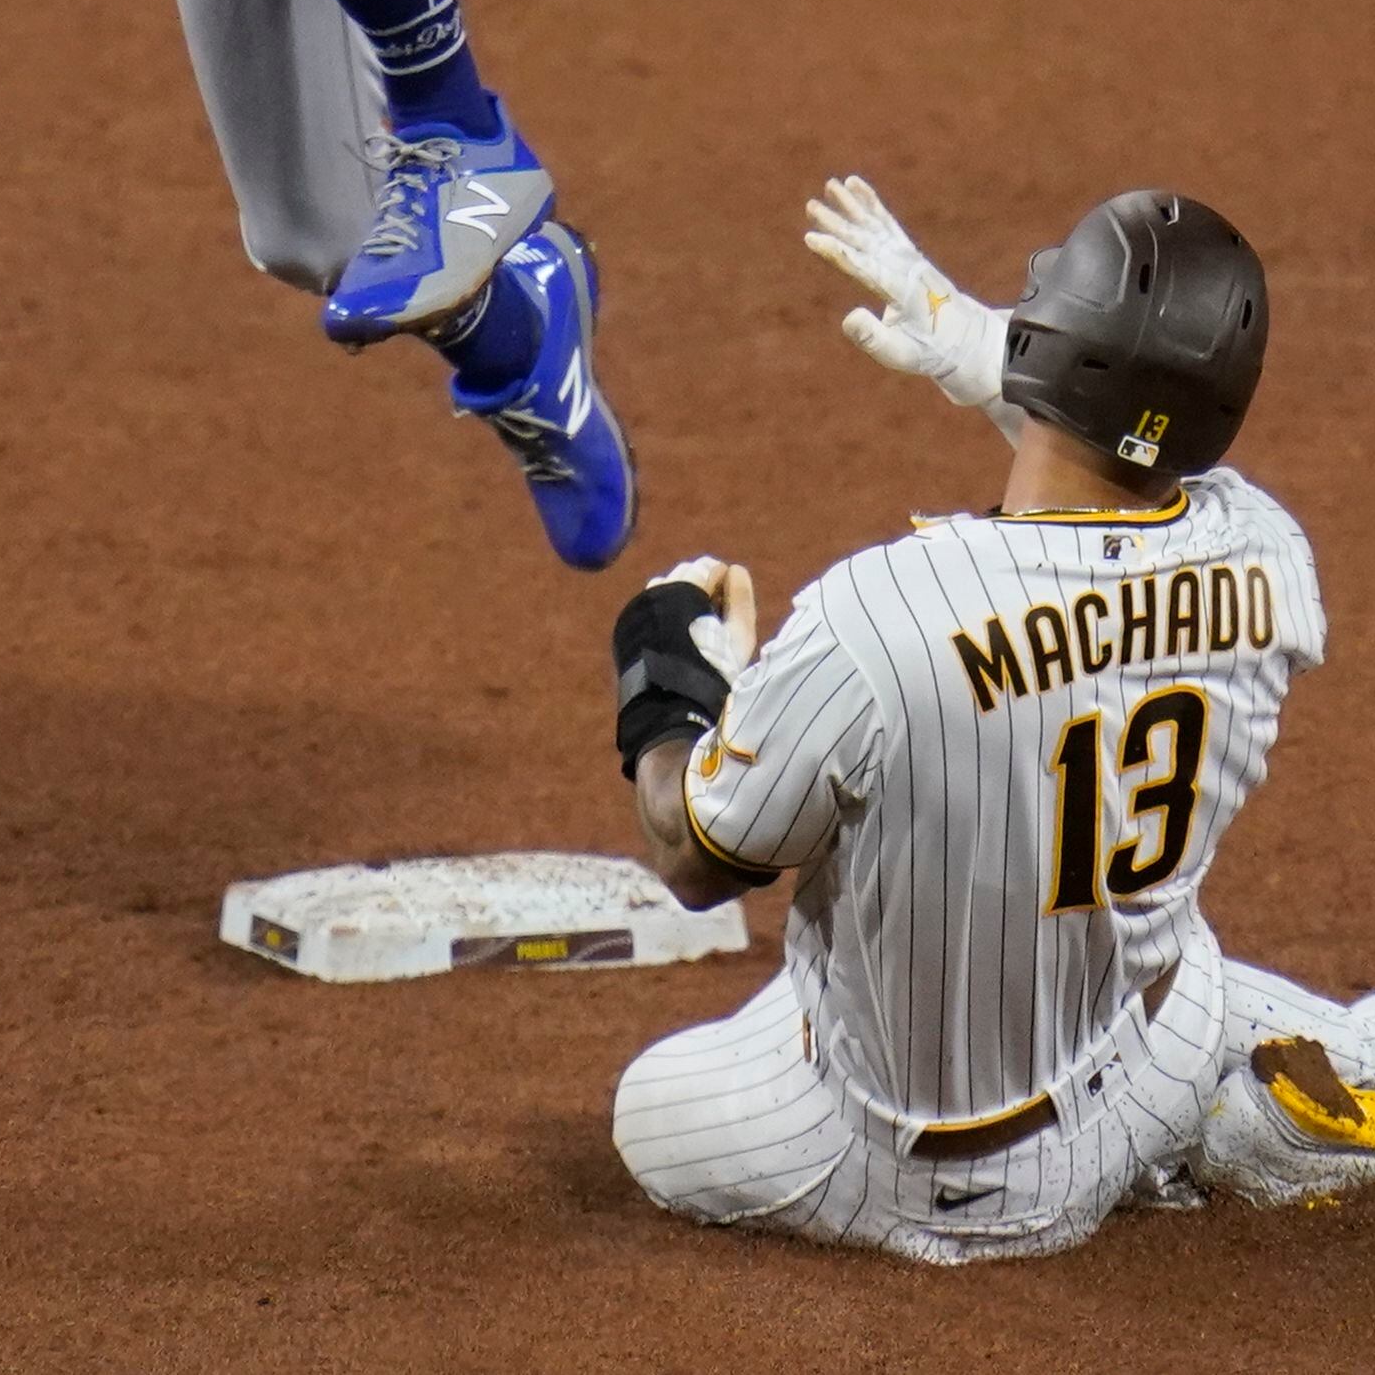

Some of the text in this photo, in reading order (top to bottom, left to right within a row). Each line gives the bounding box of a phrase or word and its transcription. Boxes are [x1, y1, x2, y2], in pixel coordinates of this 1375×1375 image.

[445, 180, 512, 241] N
[1134, 410, 1170, 442] 13
[950, 563, 1275, 715] MACHADO
[1042, 683, 1209, 918] 13
